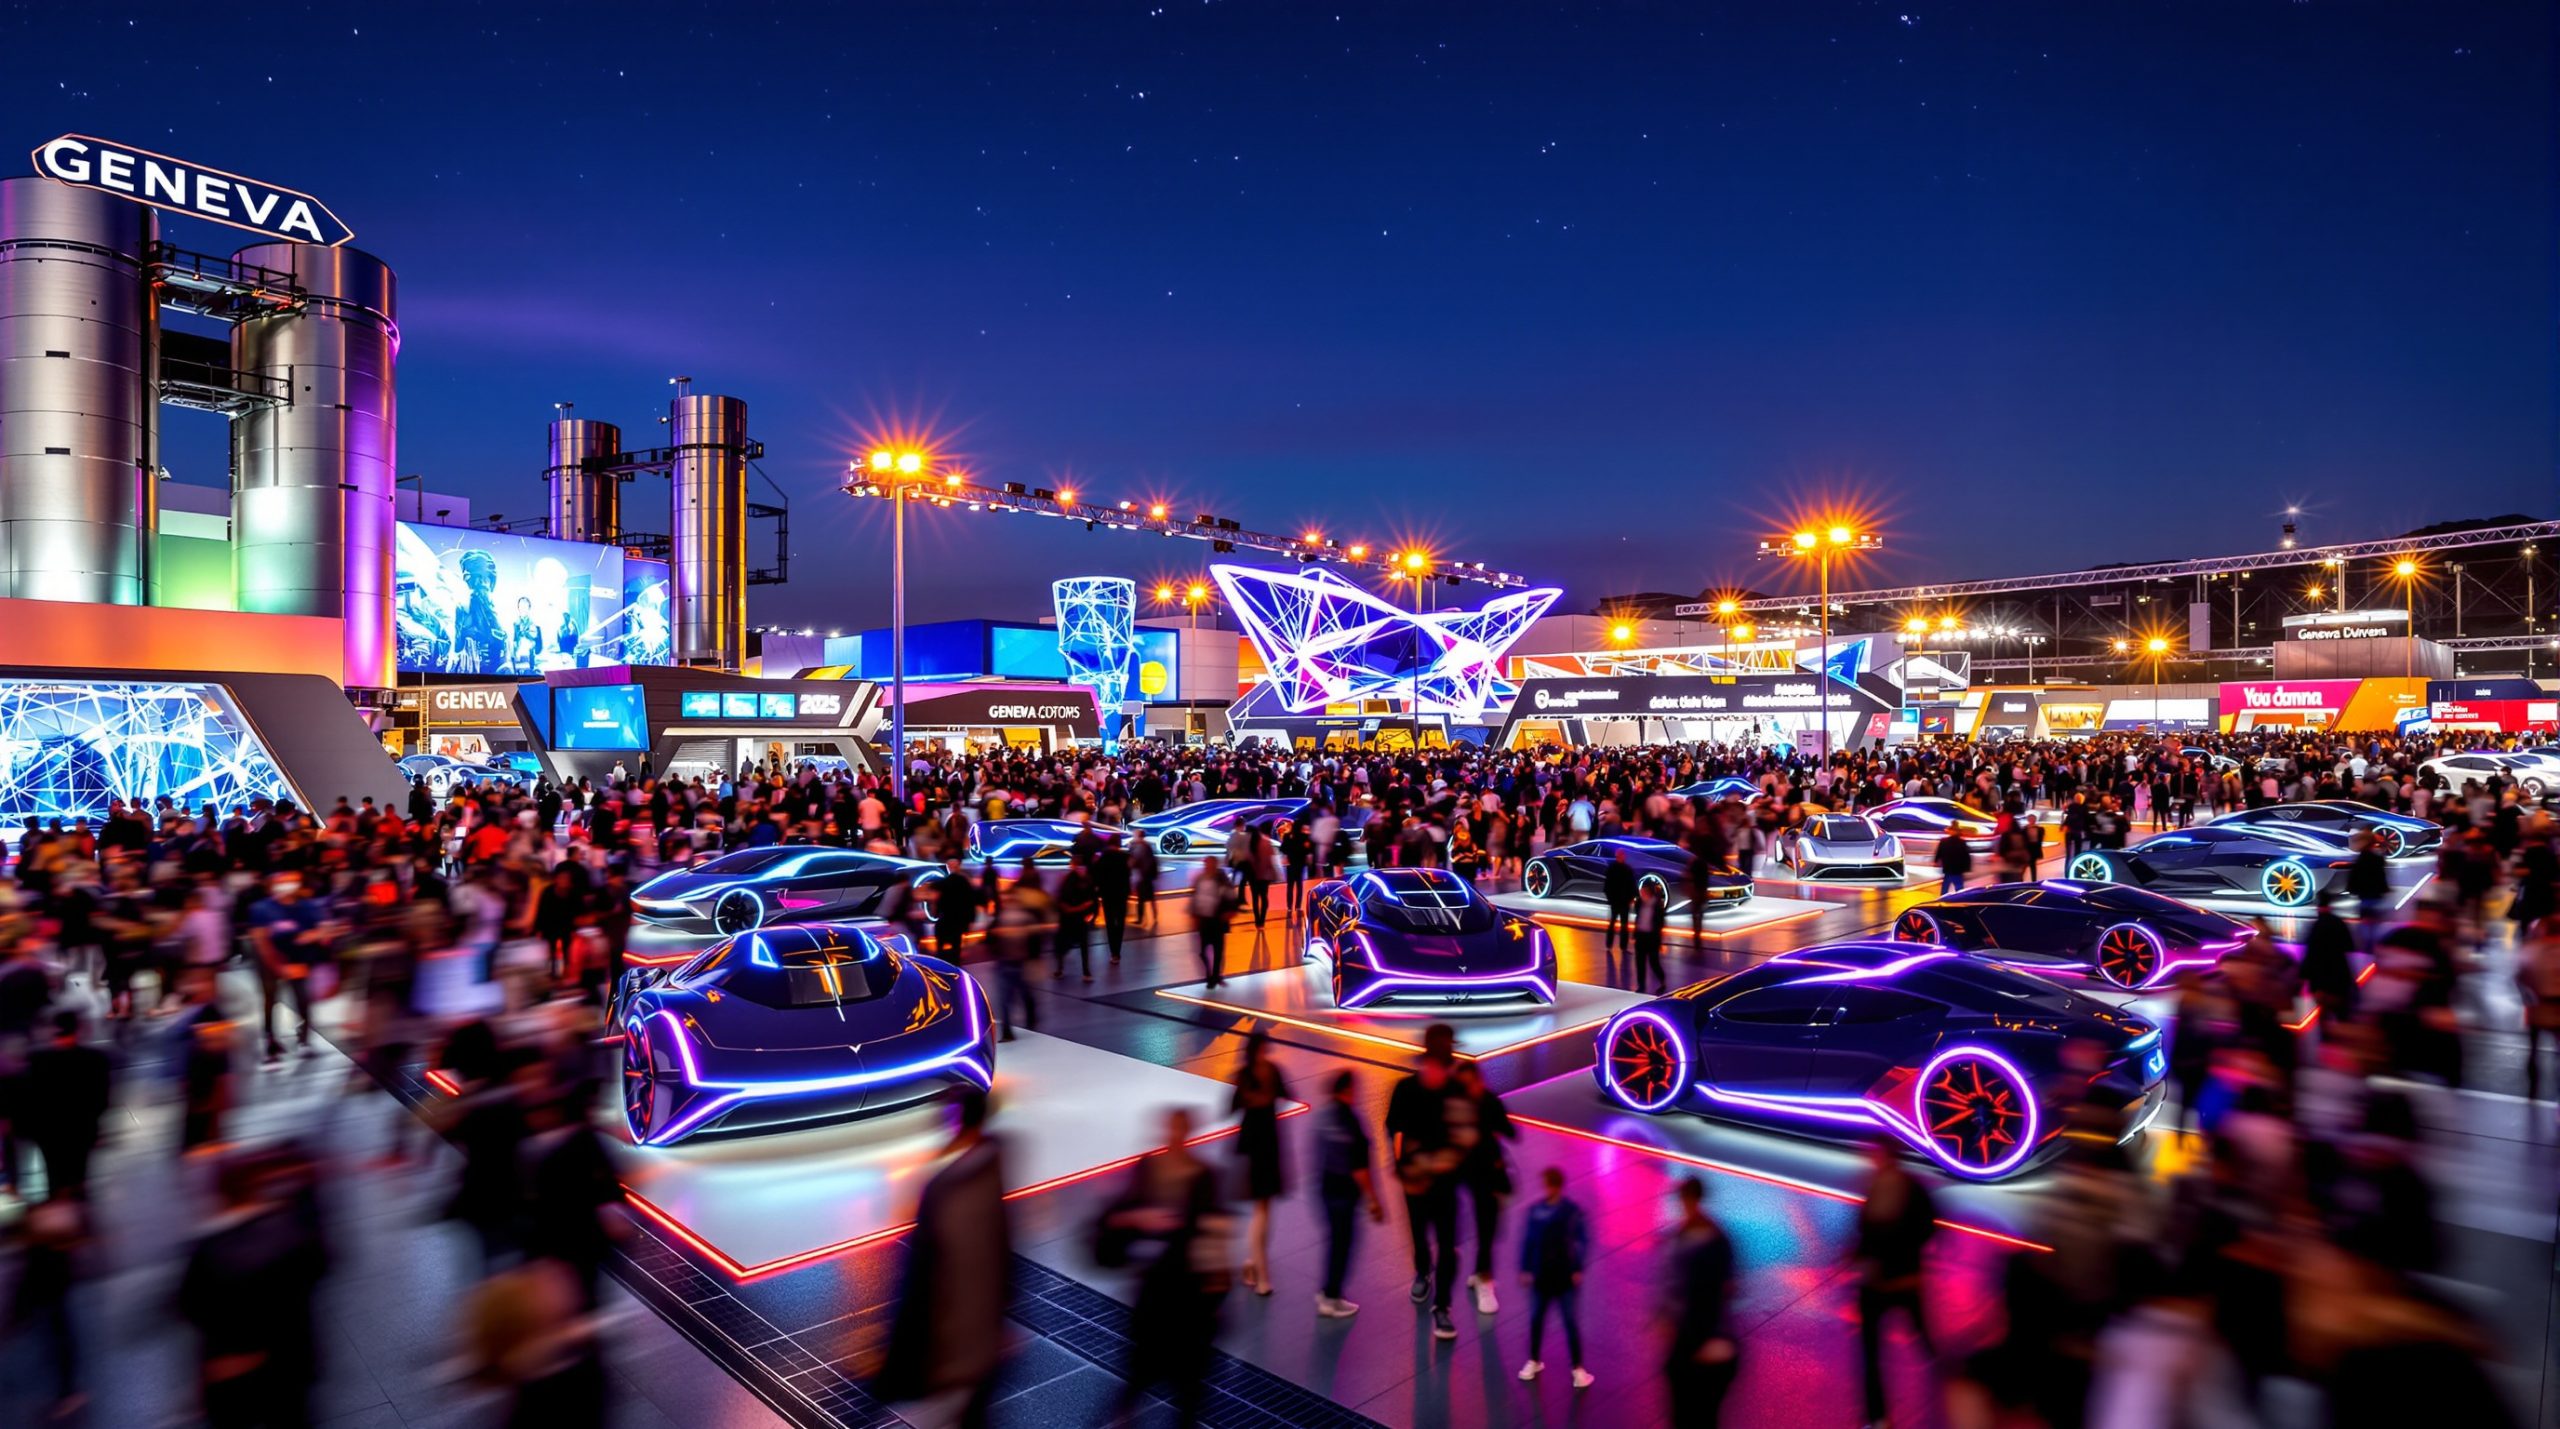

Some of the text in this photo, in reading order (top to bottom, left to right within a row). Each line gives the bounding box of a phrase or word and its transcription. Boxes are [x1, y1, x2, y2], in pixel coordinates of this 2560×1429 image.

[43, 138, 325, 243] GENEVA
[435, 691, 508, 710] GENEVA
[799, 694, 841, 714] 2025
[2243, 687, 2271, 707] You
[988, 705, 1036, 719] GENEVA
